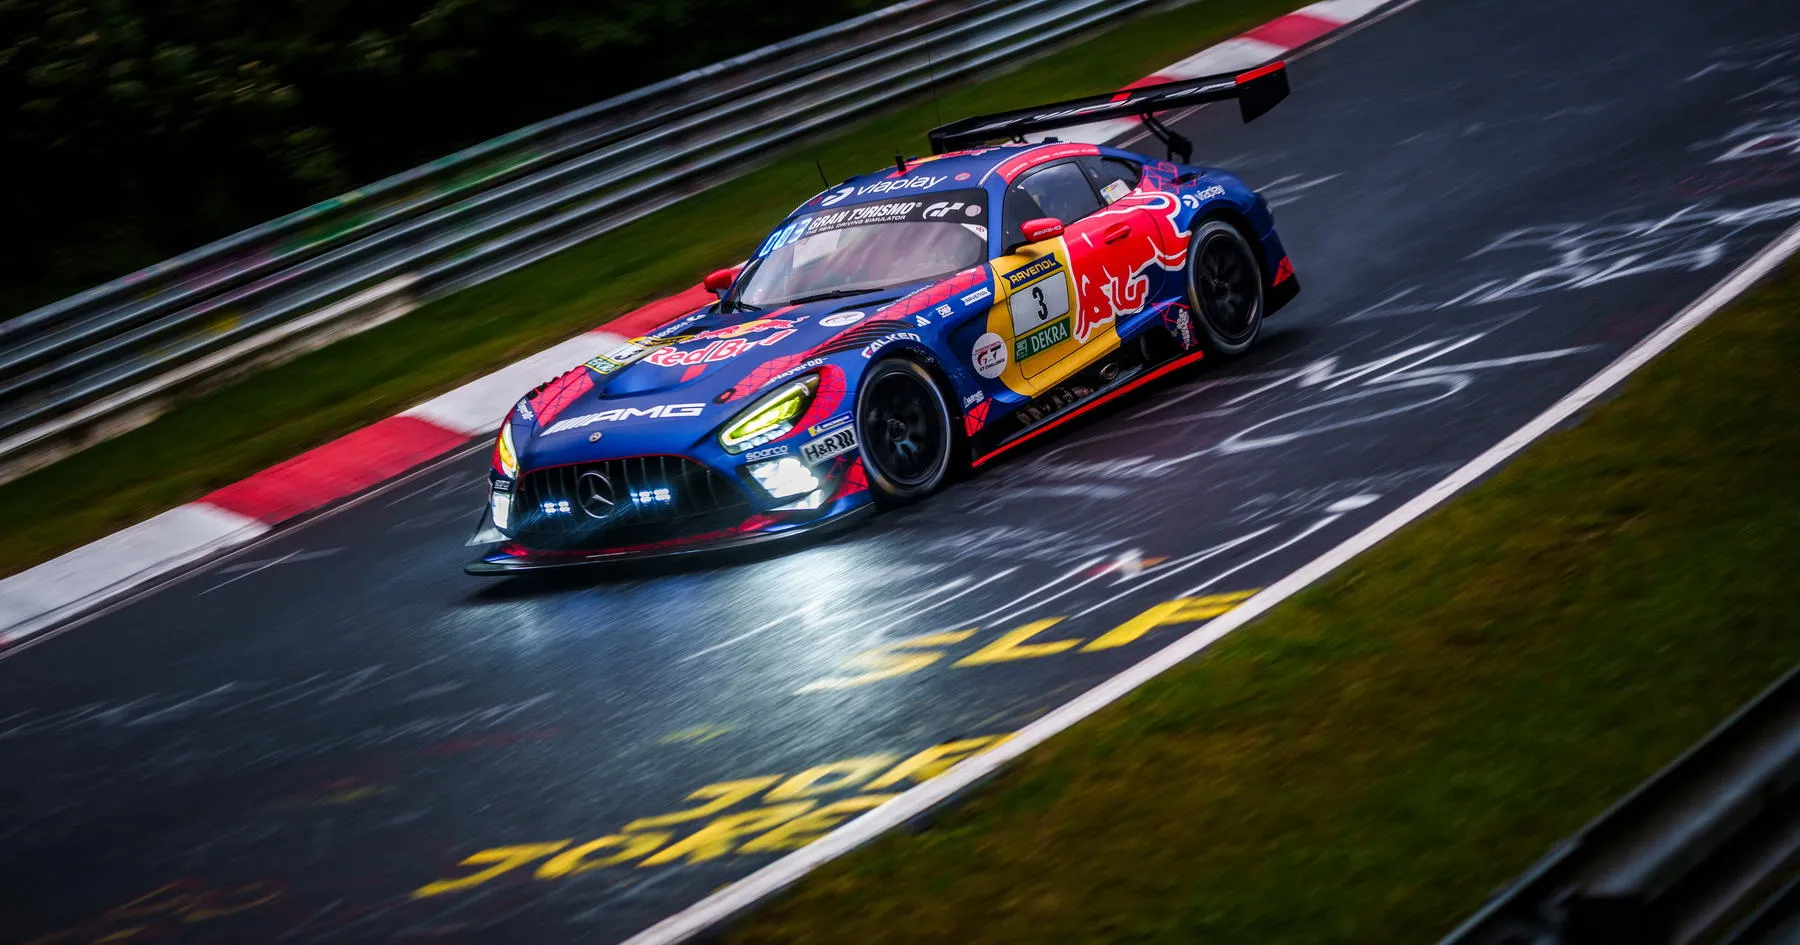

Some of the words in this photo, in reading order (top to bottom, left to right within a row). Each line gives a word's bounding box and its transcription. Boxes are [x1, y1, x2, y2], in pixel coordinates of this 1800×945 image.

[857, 176, 948, 196] viaplay
[1195, 185, 1225, 200] viaplay
[809, 211, 850, 230] GRAN
[836, 219, 863, 229] DRIVING
[864, 215, 906, 224] SIMULATOR
[759, 218, 812, 257] 003
[1010, 259, 1056, 284] RAVENOL
[1032, 286, 1048, 320] 3
[861, 333, 921, 359] FALKEN
[1031, 322, 1068, 353] DEKRA
[642, 340, 724, 367] Red
[586, 403, 705, 422] AMG
[745, 445, 788, 460] sparco
[805, 438, 837, 461] H&R
